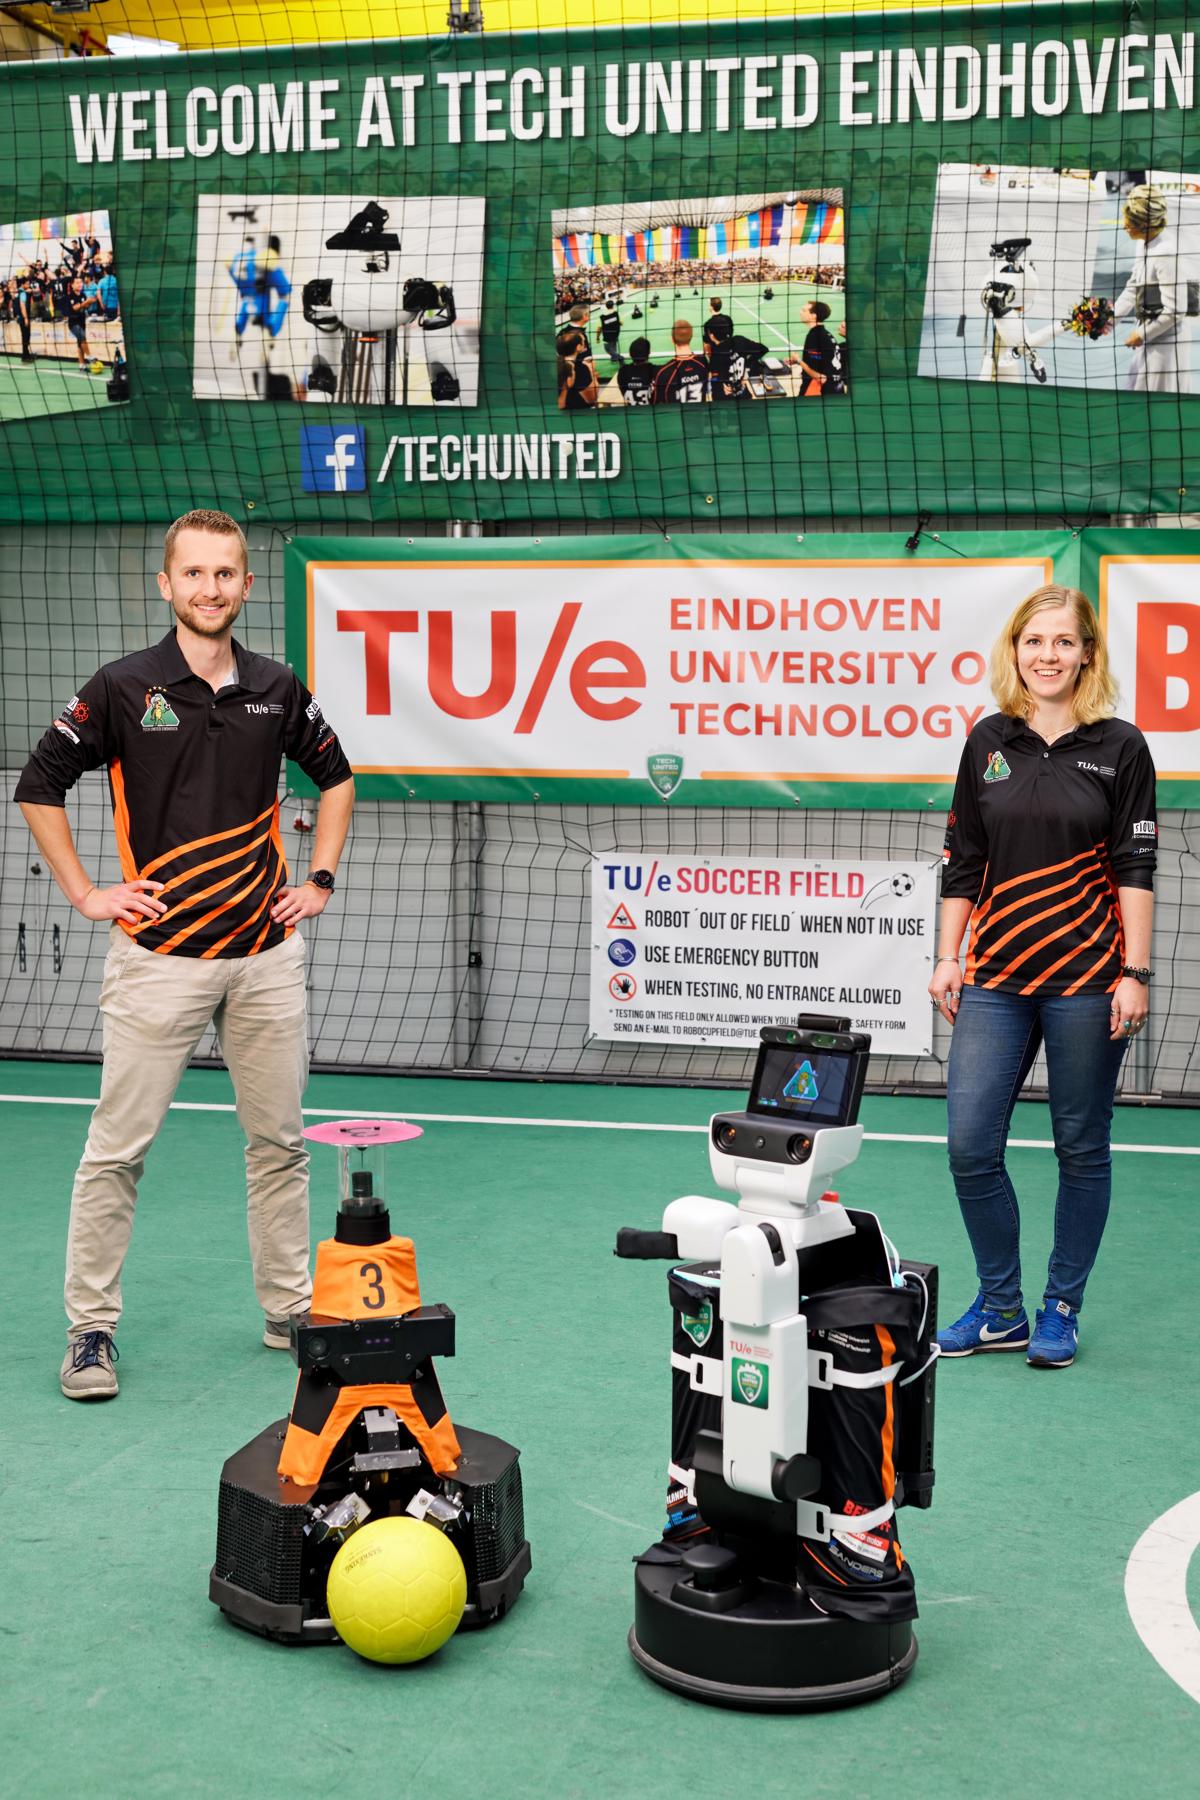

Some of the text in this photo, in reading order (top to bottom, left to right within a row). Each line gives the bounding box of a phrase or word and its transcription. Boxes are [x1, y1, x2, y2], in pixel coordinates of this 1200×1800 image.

[68, 33, 1196, 163] WELCOME AT TECH UNITED EINDHOVEN
[377, 433, 621, 483] /TECHUNITED
[670, 598, 941, 631] EINDHOVEN
[336, 602, 647, 734] TU/e
[670, 651, 986, 685] UNIVERSITY O
[244, 703, 269, 715] TU/e
[670, 703, 985, 739] TECHNOLOGY
[603, 861, 865, 898] TU/e SOCCER FIELD
[645, 910, 691, 929] ROBOT
[730, 912, 748, 931] OF
[800, 915, 843, 934] WHEN
[847, 916, 876, 935] NOT
[879, 918, 894, 936] IN
[897, 918, 925, 937] USE
[645, 945, 819, 969] USE EMERGENCY BUTTON
[645, 979, 902, 1005] WHEN TESTING, NO ENTRANCE ALLOWED
[613, 1023, 759, 1039] SEND AN E-MAIL TO ROBOCUPFIELD@TUE.
[615, 1009, 644, 1019] TESTING
[645, 1010, 656, 1019] ON
[657, 1011, 673, 1020] THIS
[674, 1011, 695, 1021] FIELD
[696, 1012, 714, 1022] ONLY
[715, 1013, 750, 1024] ALLOWED
[751, 1015, 773, 1026] WHEN
[774, 1016, 789, 1025] YOU
[790, 1017, 799, 1025] HA
[855, 1019, 883, 1029] SAFETY
[885, 1020, 906, 1030] FORM
[359, 1262, 386, 1311] 3
[829, 1545, 885, 1579] SANDERS
